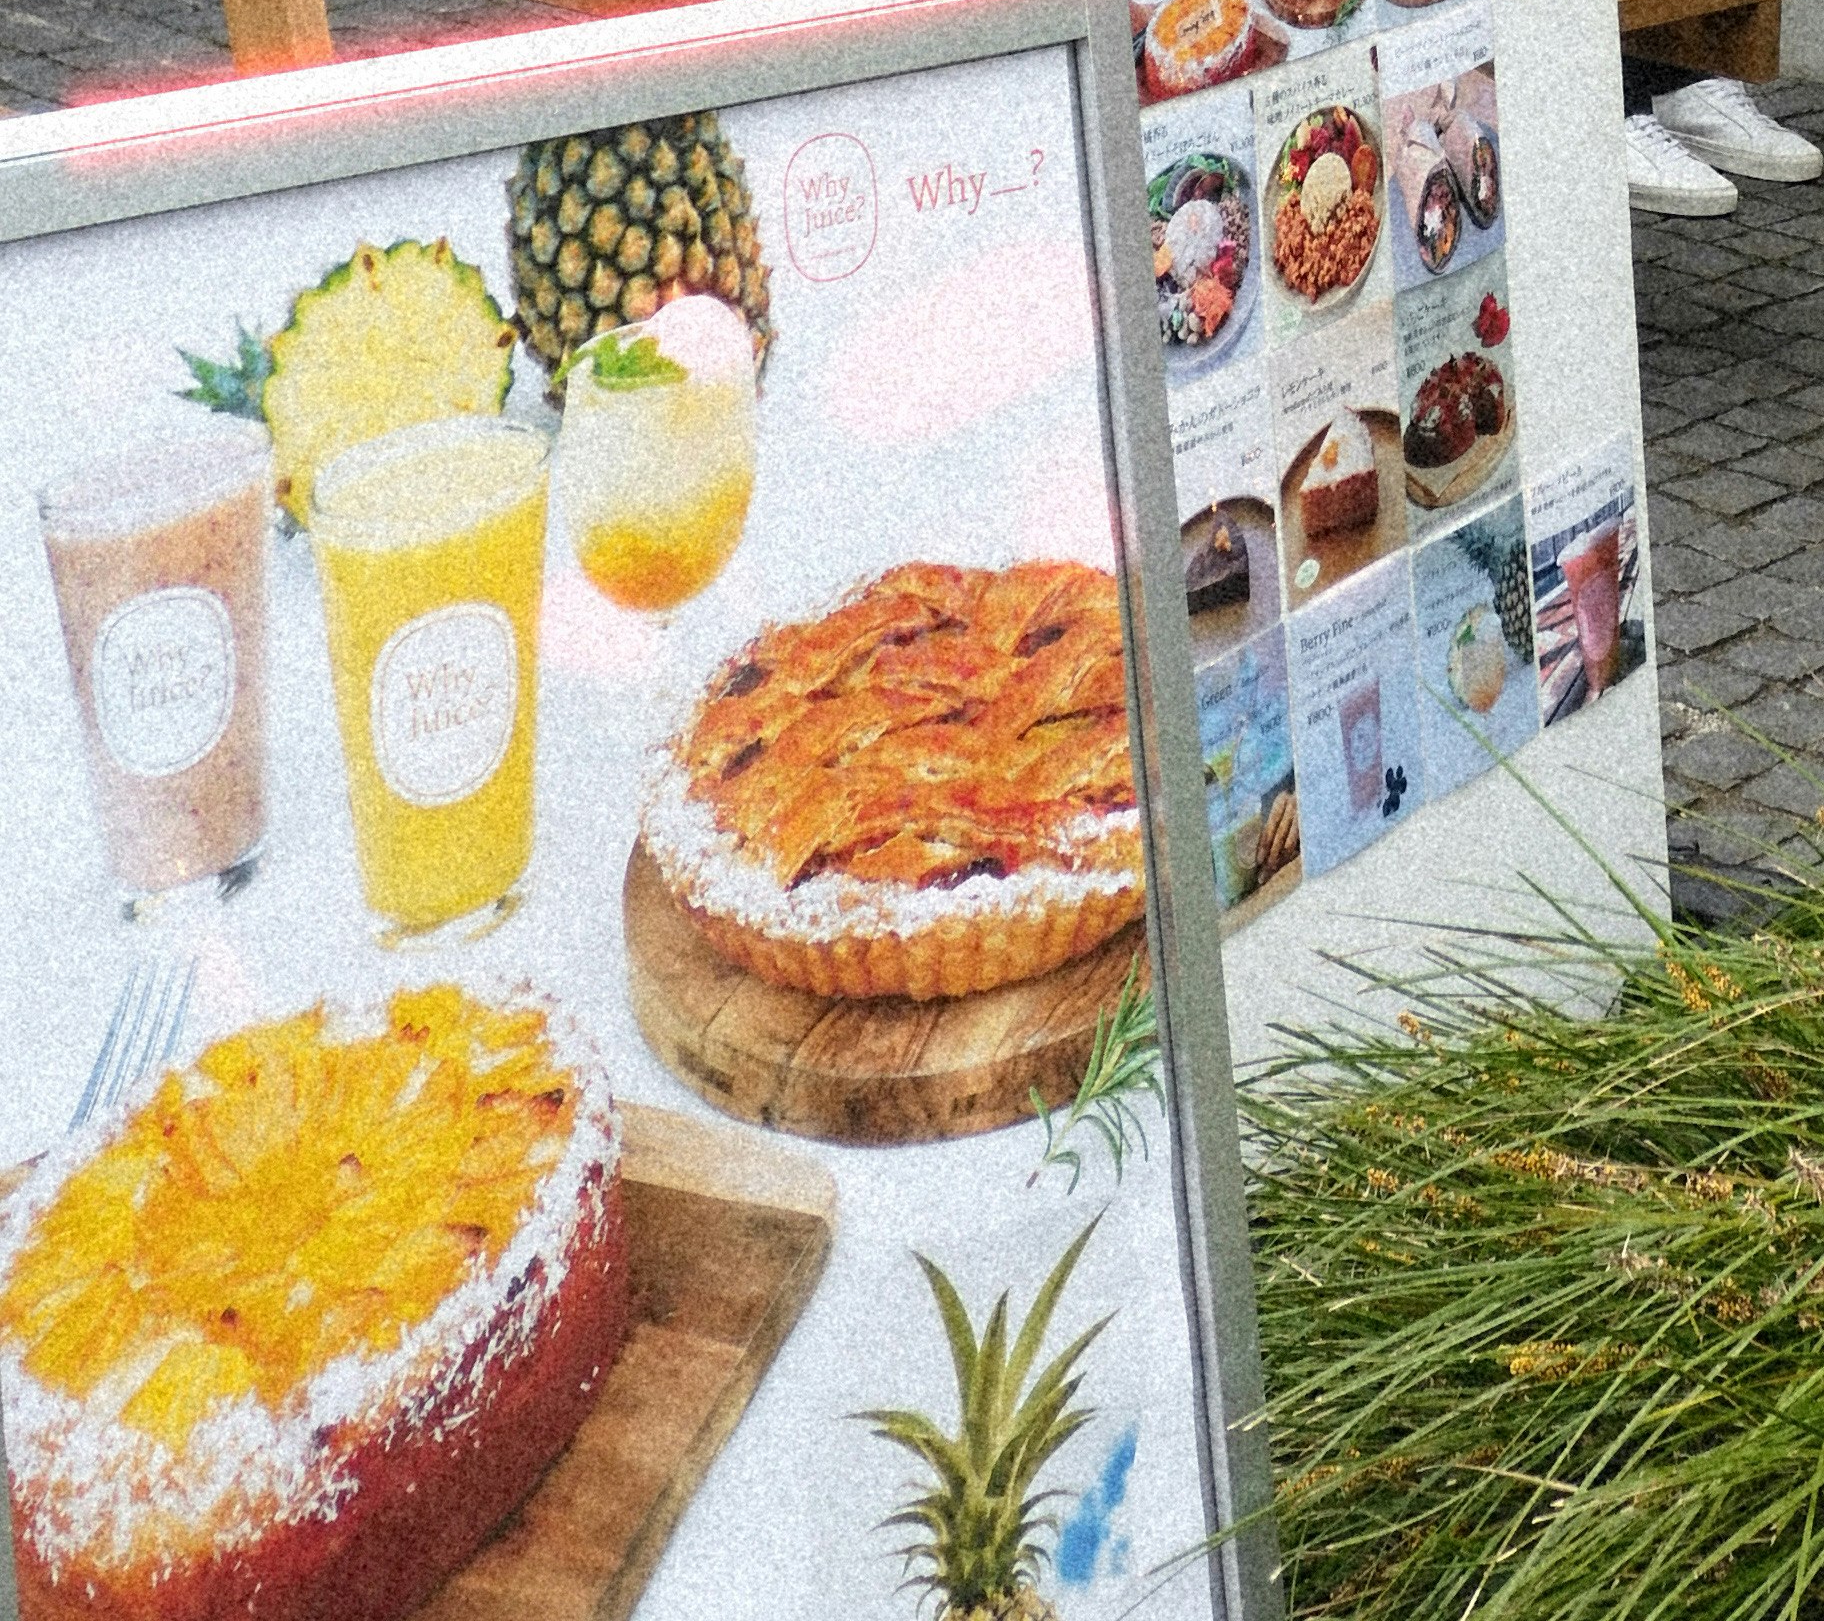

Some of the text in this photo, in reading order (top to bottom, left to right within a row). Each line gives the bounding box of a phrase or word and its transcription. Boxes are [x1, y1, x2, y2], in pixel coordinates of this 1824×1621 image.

[799, 171, 850, 205] Why
[803, 195, 866, 239] Juice?
[1300, 616, 1354, 655] Berry Fine
[404, 661, 478, 701] Why
[1201, 683, 1233, 709] Green
